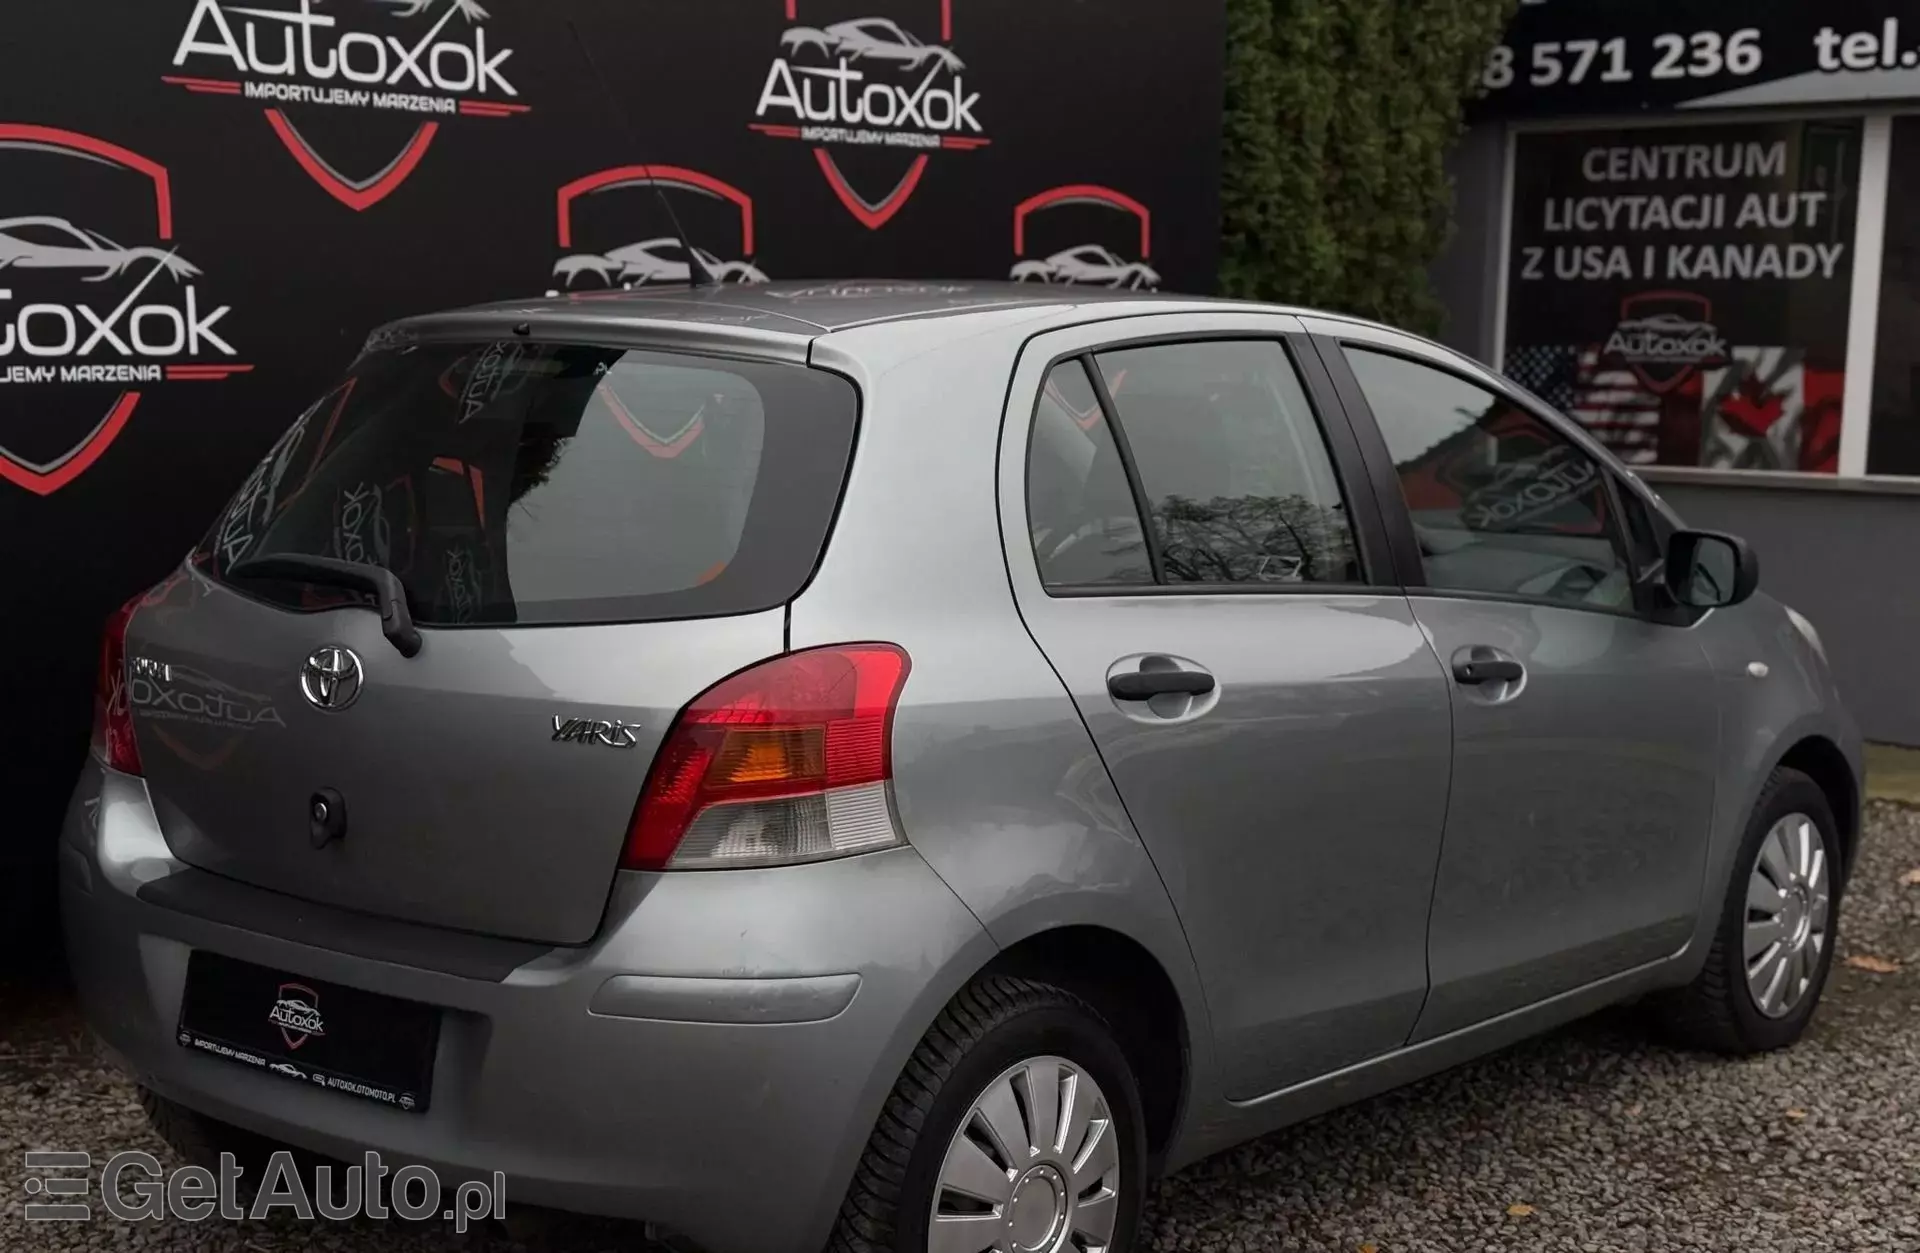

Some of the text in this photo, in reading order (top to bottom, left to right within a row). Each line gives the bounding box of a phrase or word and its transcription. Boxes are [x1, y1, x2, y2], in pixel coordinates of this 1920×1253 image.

[173, 0, 518, 95] Autoxok
[1529, 37, 1633, 86] 571
[1651, 29, 1763, 79] 236
[244, 81, 456, 113] IMPORTUJEMY MARZENIA
[756, 57, 982, 132] Autoxok
[1582, 141, 1787, 182] CENTRUM
[1543, 191, 1827, 231] LICYTACJI AUT
[1520, 243, 1844, 281] Z USA I KANADY
[1603, 329, 1726, 357] Autoxok
[60, 364, 162, 382] MARZENIA
[269, 1005, 324, 1032] Autoxok
[327, 1076, 396, 1103] AUTOXOK.OTOMOTO.PL
